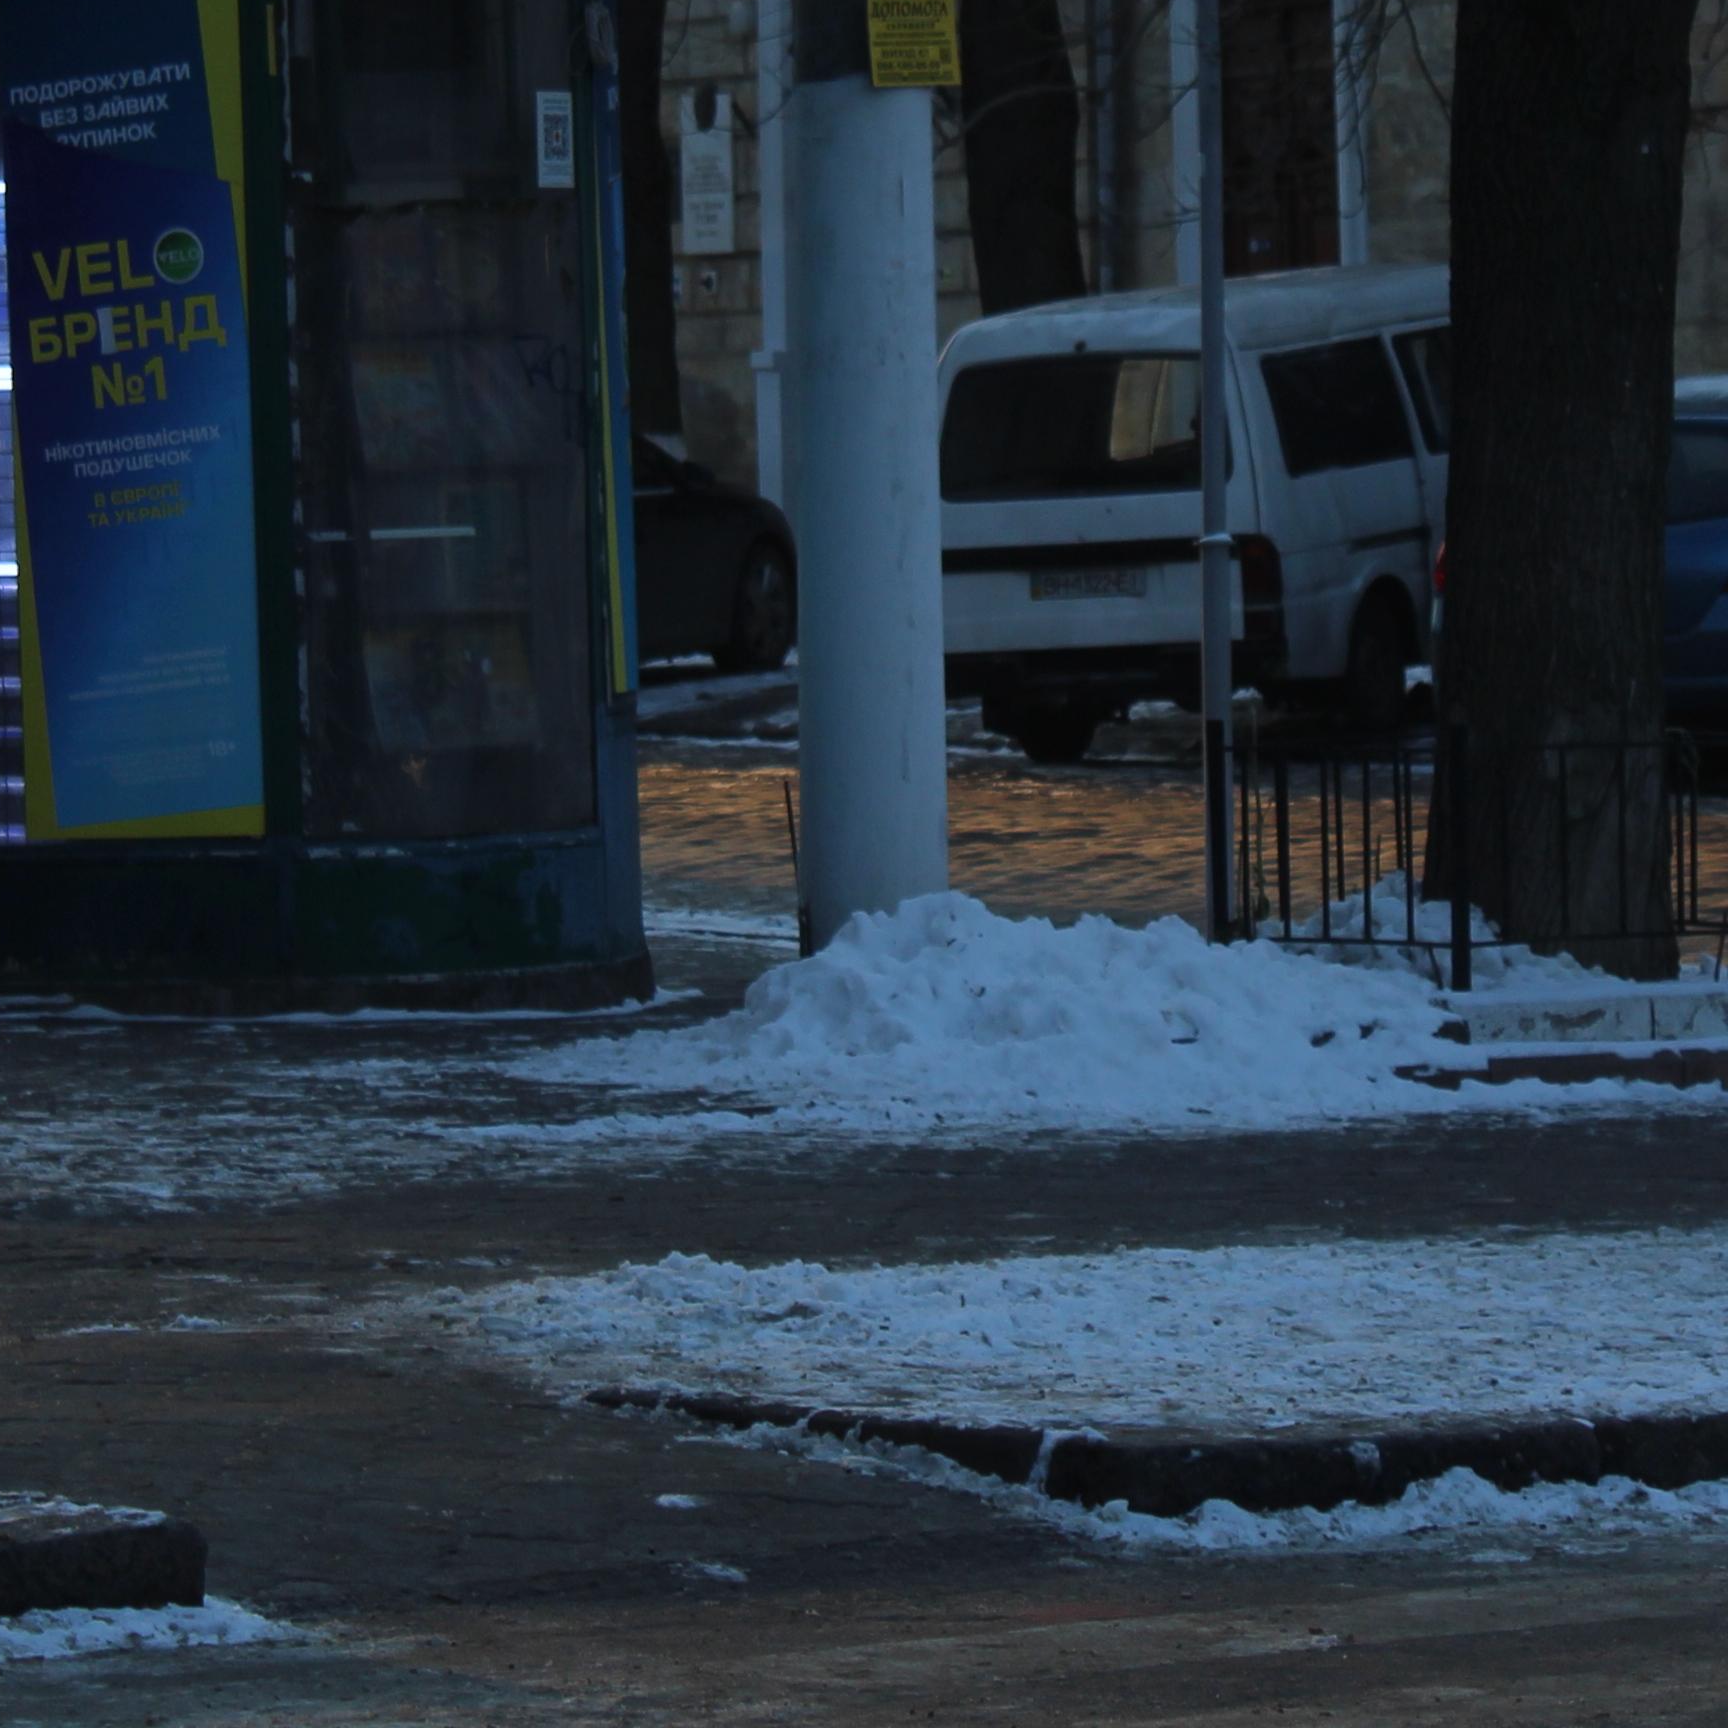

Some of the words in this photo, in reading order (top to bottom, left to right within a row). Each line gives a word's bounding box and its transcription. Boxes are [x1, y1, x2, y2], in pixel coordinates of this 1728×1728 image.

[872, 0, 949, 18] ДОПОМОГА
[10, 62, 190, 106] ПОДОРОЖУВАТИ
[40, 106, 78, 129] БЕЗ
[83, 93, 169, 122] ЗАЙВИХ
[28, 294, 227, 364] БРЕНД
[90, 355, 168, 409] №1
[74, 448, 194, 478] ПОДУШЕЧОК
[94, 492, 106, 509] В
[88, 512, 110, 528] ТА
